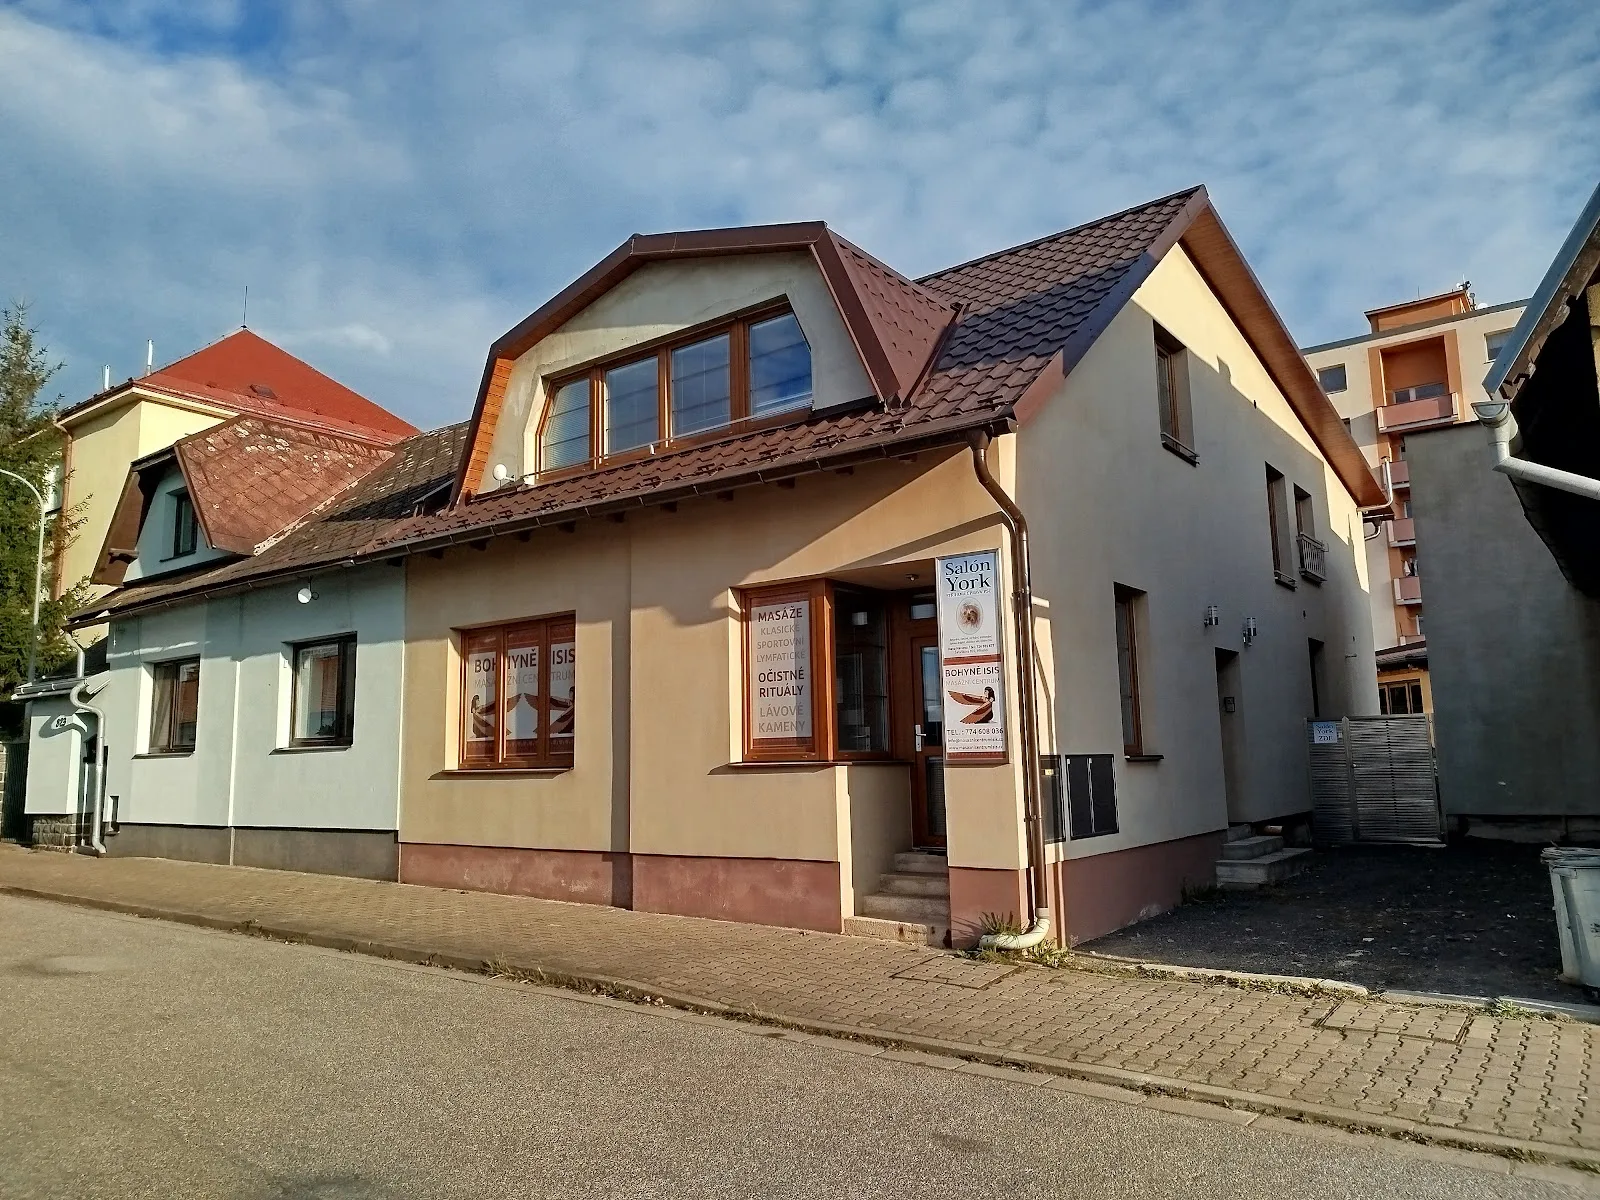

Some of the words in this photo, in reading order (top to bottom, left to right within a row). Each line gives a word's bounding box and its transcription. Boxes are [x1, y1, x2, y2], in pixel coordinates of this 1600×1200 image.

[945, 559, 991, 576] Salón
[945, 573, 991, 592] York
[758, 605, 803, 623] MASÁŽE
[756, 634, 804, 650] SPORTOVNÍ
[552, 648, 576, 666] ISIS
[756, 649, 806, 663] LYMFATICKÉ
[758, 666, 805, 683] OČISTNÉ
[945, 665, 982, 677] BOHYNĚ
[983, 666, 1000, 675] ISIS
[759, 682, 804, 698] RITUÁLY
[759, 702, 804, 718] LÁVOVÉ
[758, 720, 806, 733] KAMENY
